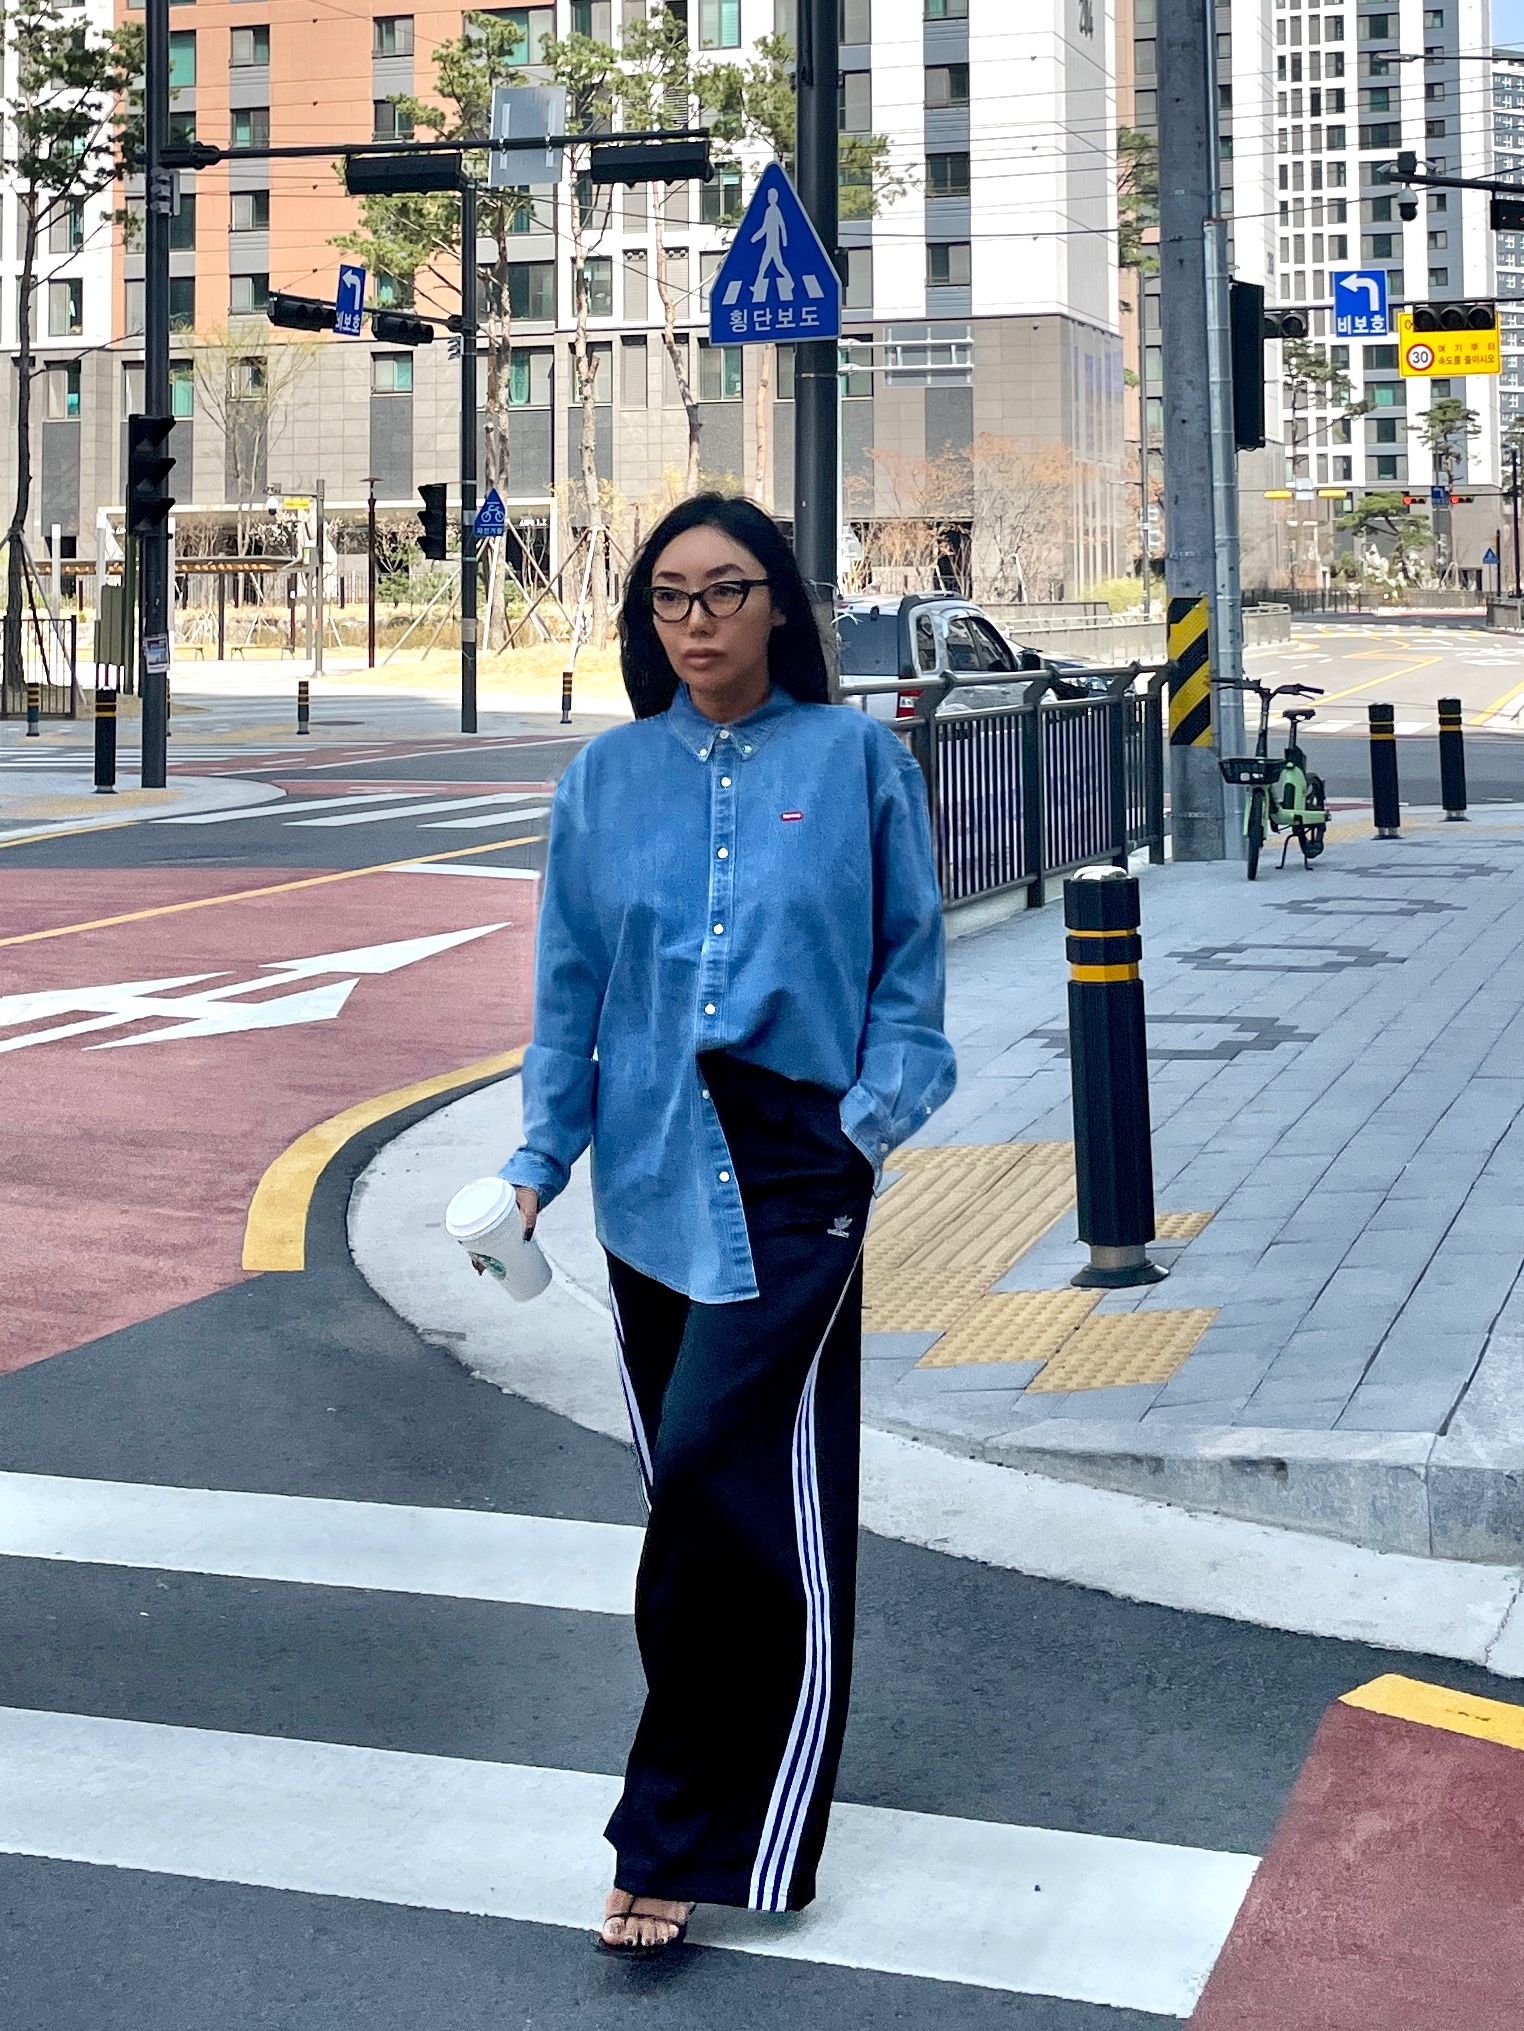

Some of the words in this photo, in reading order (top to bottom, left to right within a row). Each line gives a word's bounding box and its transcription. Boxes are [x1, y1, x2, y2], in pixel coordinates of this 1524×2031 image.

[729, 306, 821, 333] 횡단보도
[1337, 315, 1386, 335] 비보호
[1412, 351, 1429, 364] 30
